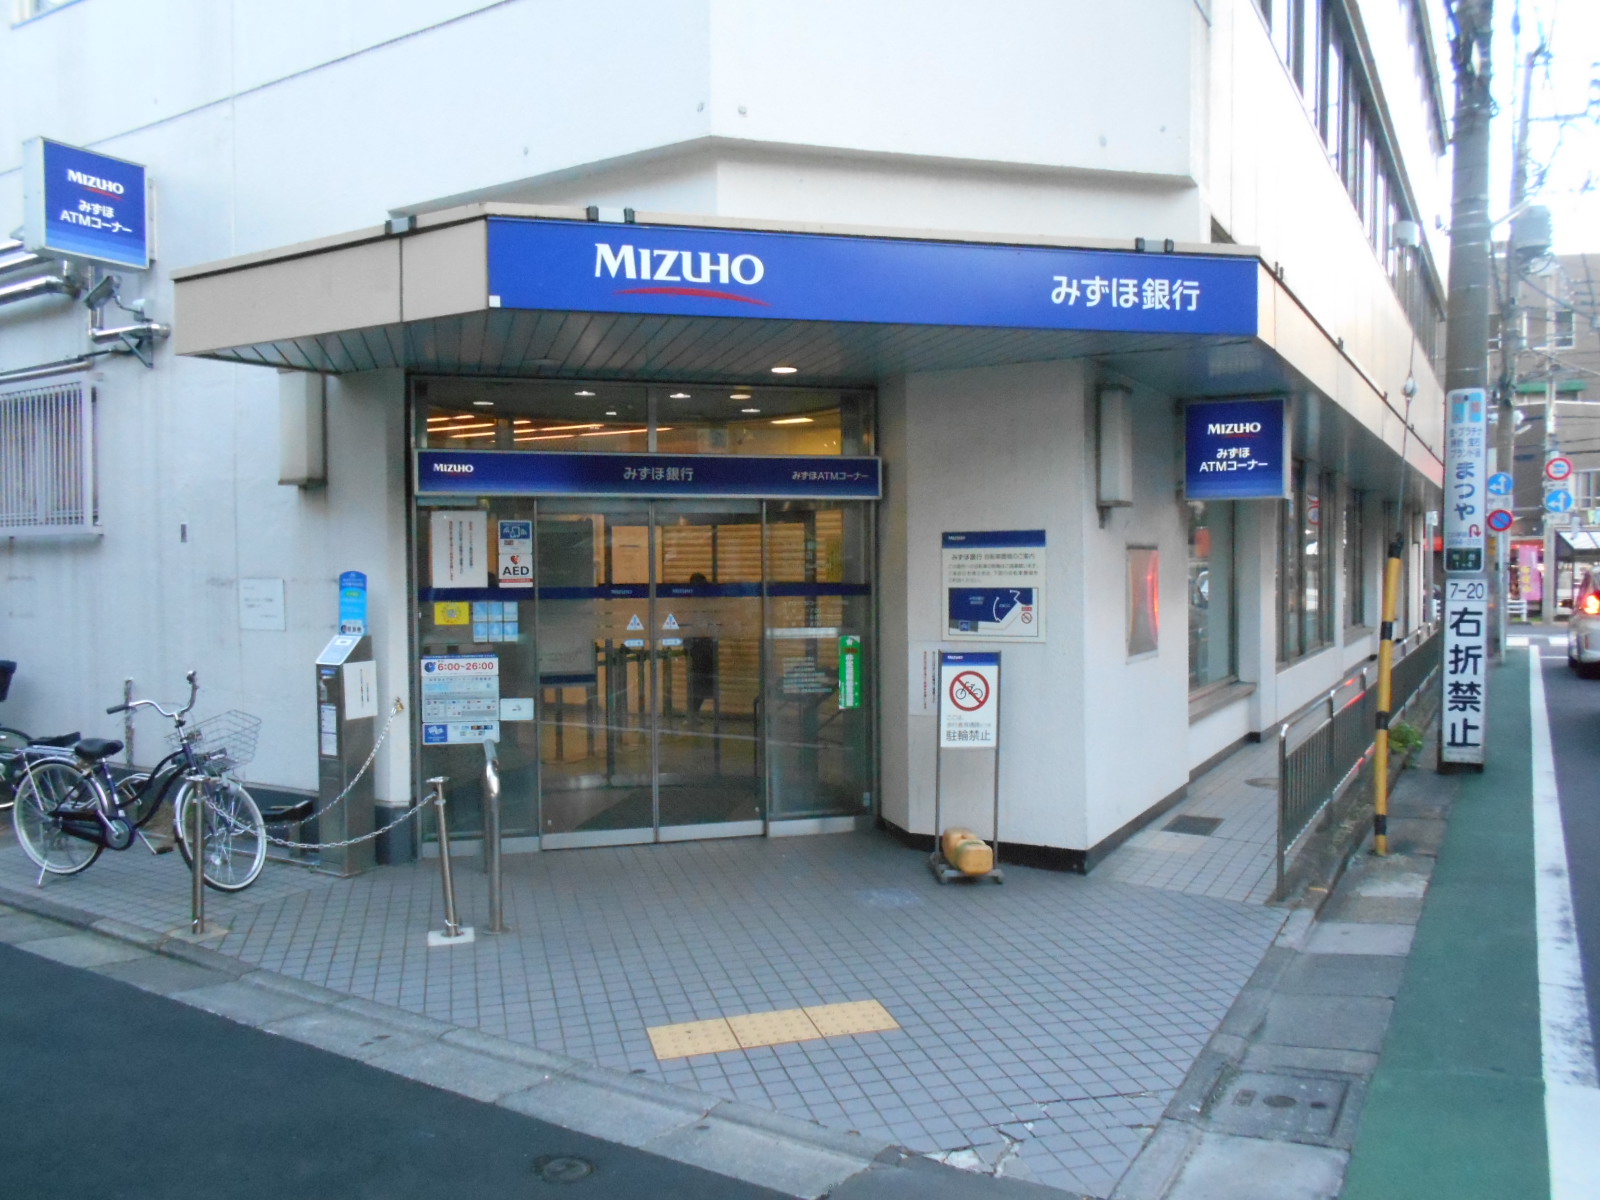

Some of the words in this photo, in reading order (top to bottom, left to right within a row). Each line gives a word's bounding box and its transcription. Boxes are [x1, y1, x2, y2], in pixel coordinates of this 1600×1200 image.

[67, 169, 124, 194] MIZUHO
[78, 199, 115, 218] みずほ
[60, 210, 133, 233] ATMコーナー
[594, 243, 765, 285] MIZUHO
[1051, 275, 1200, 312] みずほ銀行
[1207, 422, 1261, 435] MIZUHO
[1216, 447, 1251, 459] みずほ
[433, 463, 474, 474] MIZUHO
[623, 466, 694, 482] みずほ銀行
[1199, 459, 1268, 473] ATMコーナー
[1454, 461, 1475, 521] まつや
[502, 566, 530, 576] AED
[1450, 582, 1484, 599] 7-20
[1446, 607, 1483, 747] 右折禁止
[946, 730, 991, 742] 駐輪禁止
